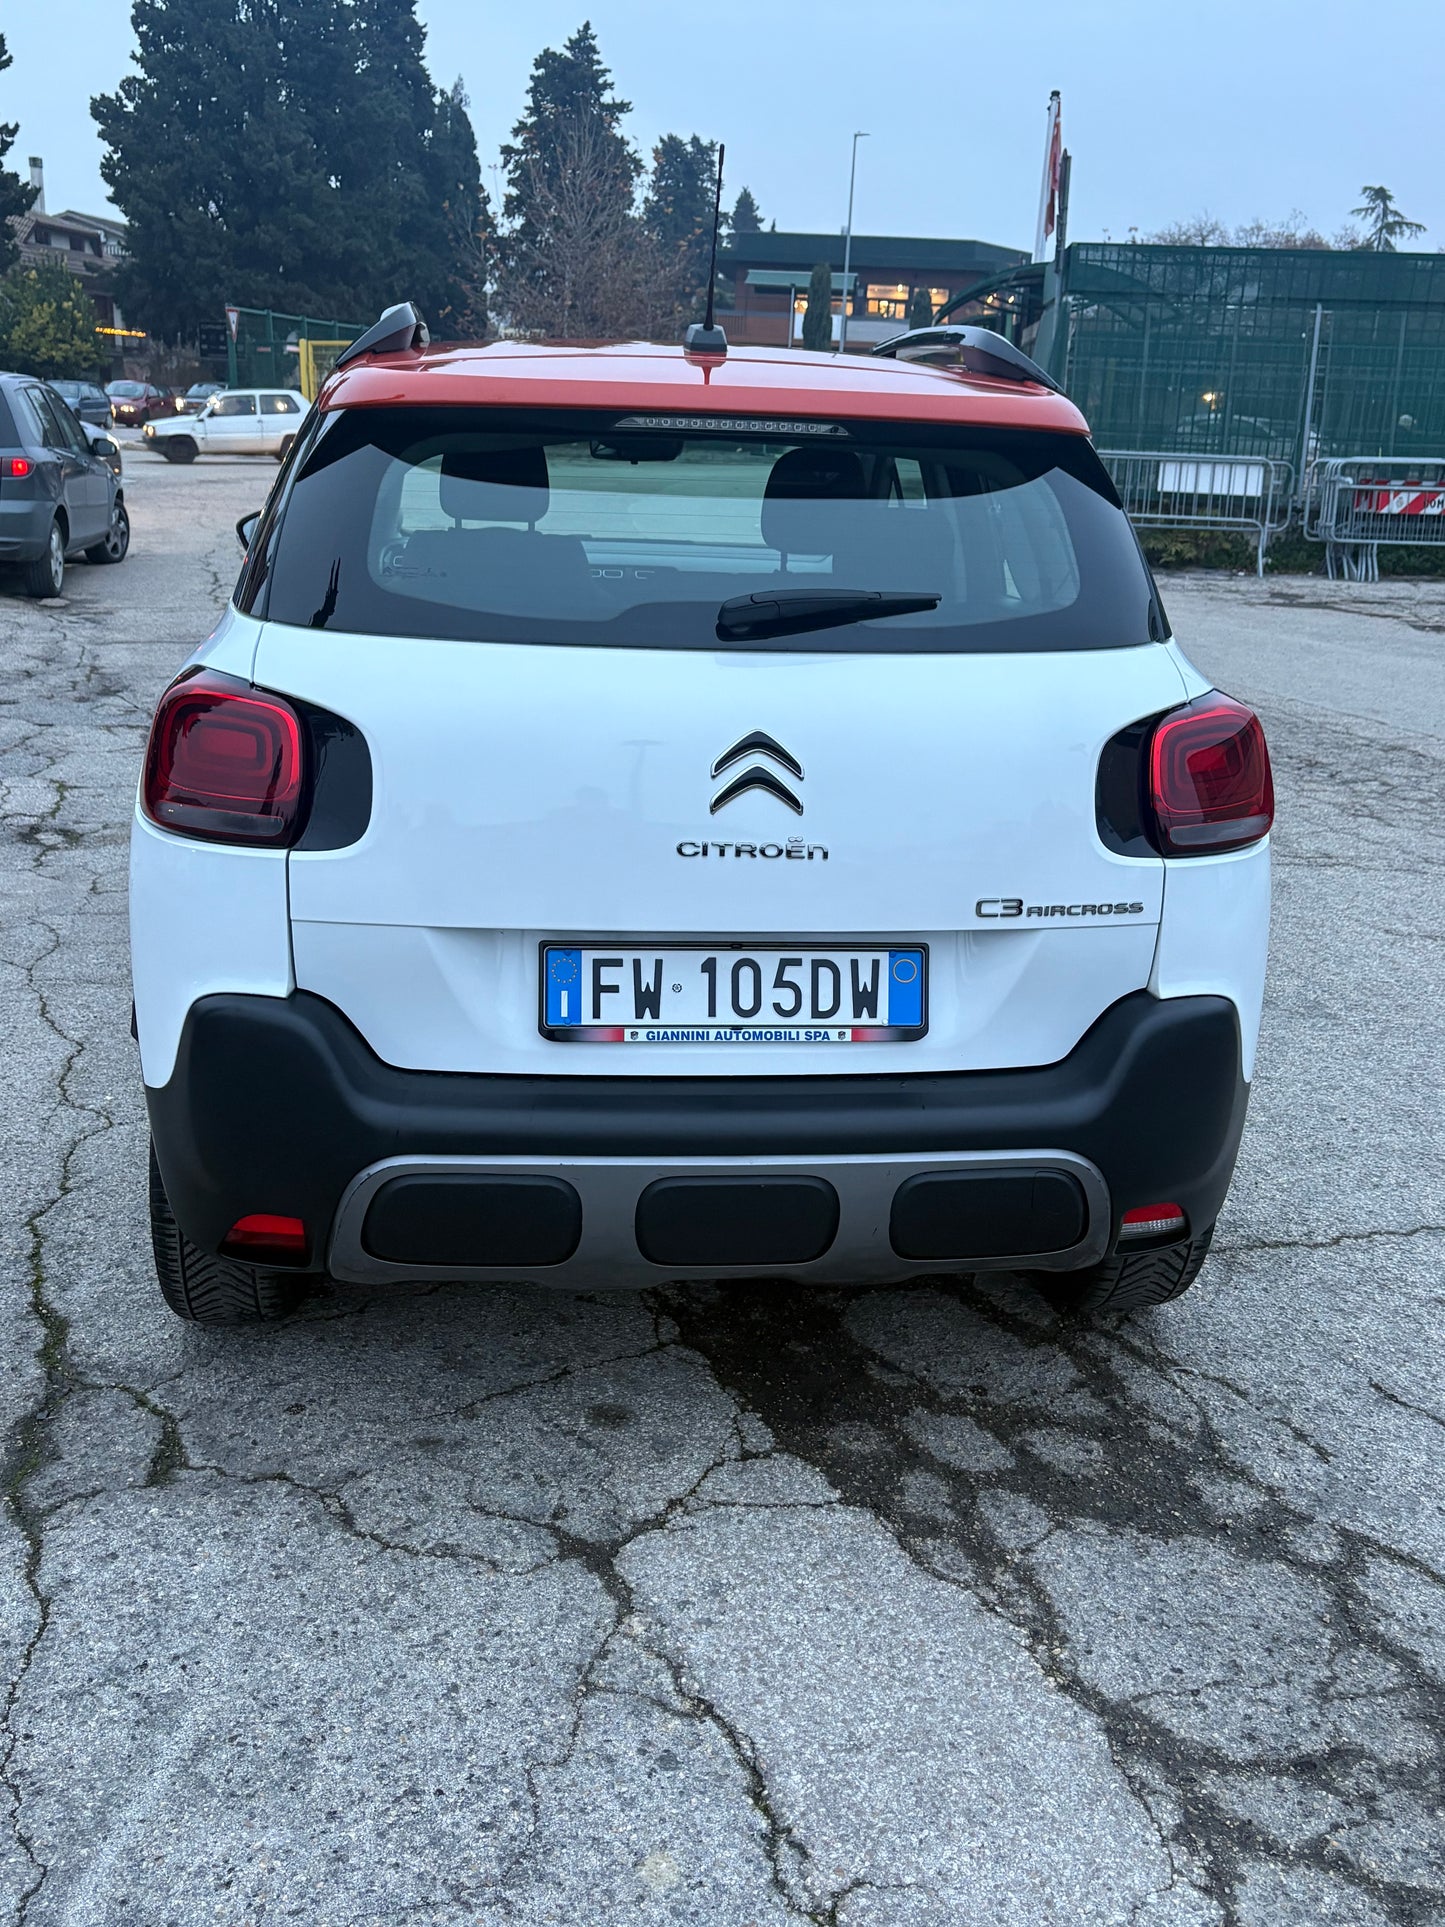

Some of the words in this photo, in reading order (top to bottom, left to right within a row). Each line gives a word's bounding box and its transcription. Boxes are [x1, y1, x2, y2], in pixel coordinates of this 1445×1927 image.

[975, 898, 1023, 918] C3
[1026, 901, 1144, 918] AIRCROSS
[645, 1030, 710, 1041] GIANNINI
[714, 1030, 800, 1041] AUTOMOBILI
[804, 1030, 831, 1041] SPA
